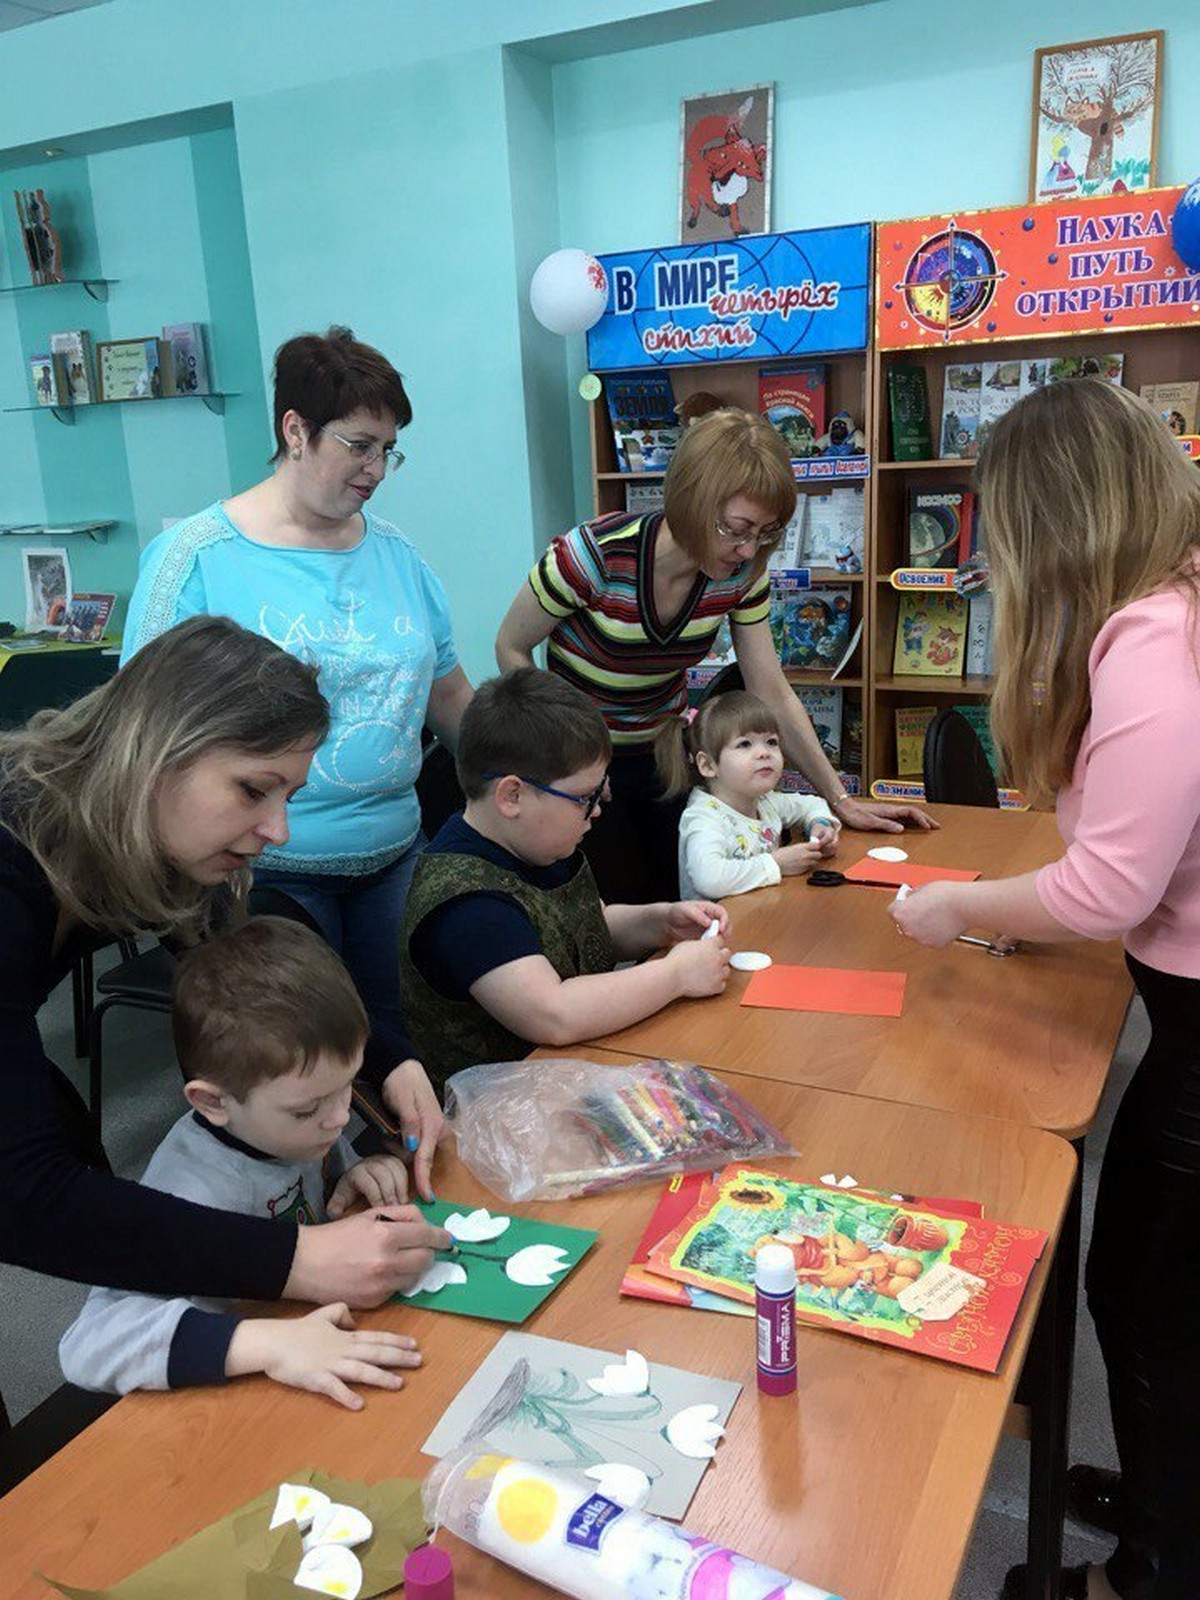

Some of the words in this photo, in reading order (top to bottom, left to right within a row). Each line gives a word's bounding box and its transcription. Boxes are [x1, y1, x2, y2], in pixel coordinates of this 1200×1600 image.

[1070, 248, 1154, 279] ПУТЬ
[614, 268, 635, 314] В
[656, 257, 738, 310] МИРЕ
[708, 280, 839, 319] четырёх
[643, 319, 755, 352] стихий
[917, 493, 962, 507] КОСМОС
[572, 1500, 608, 1538] bella
